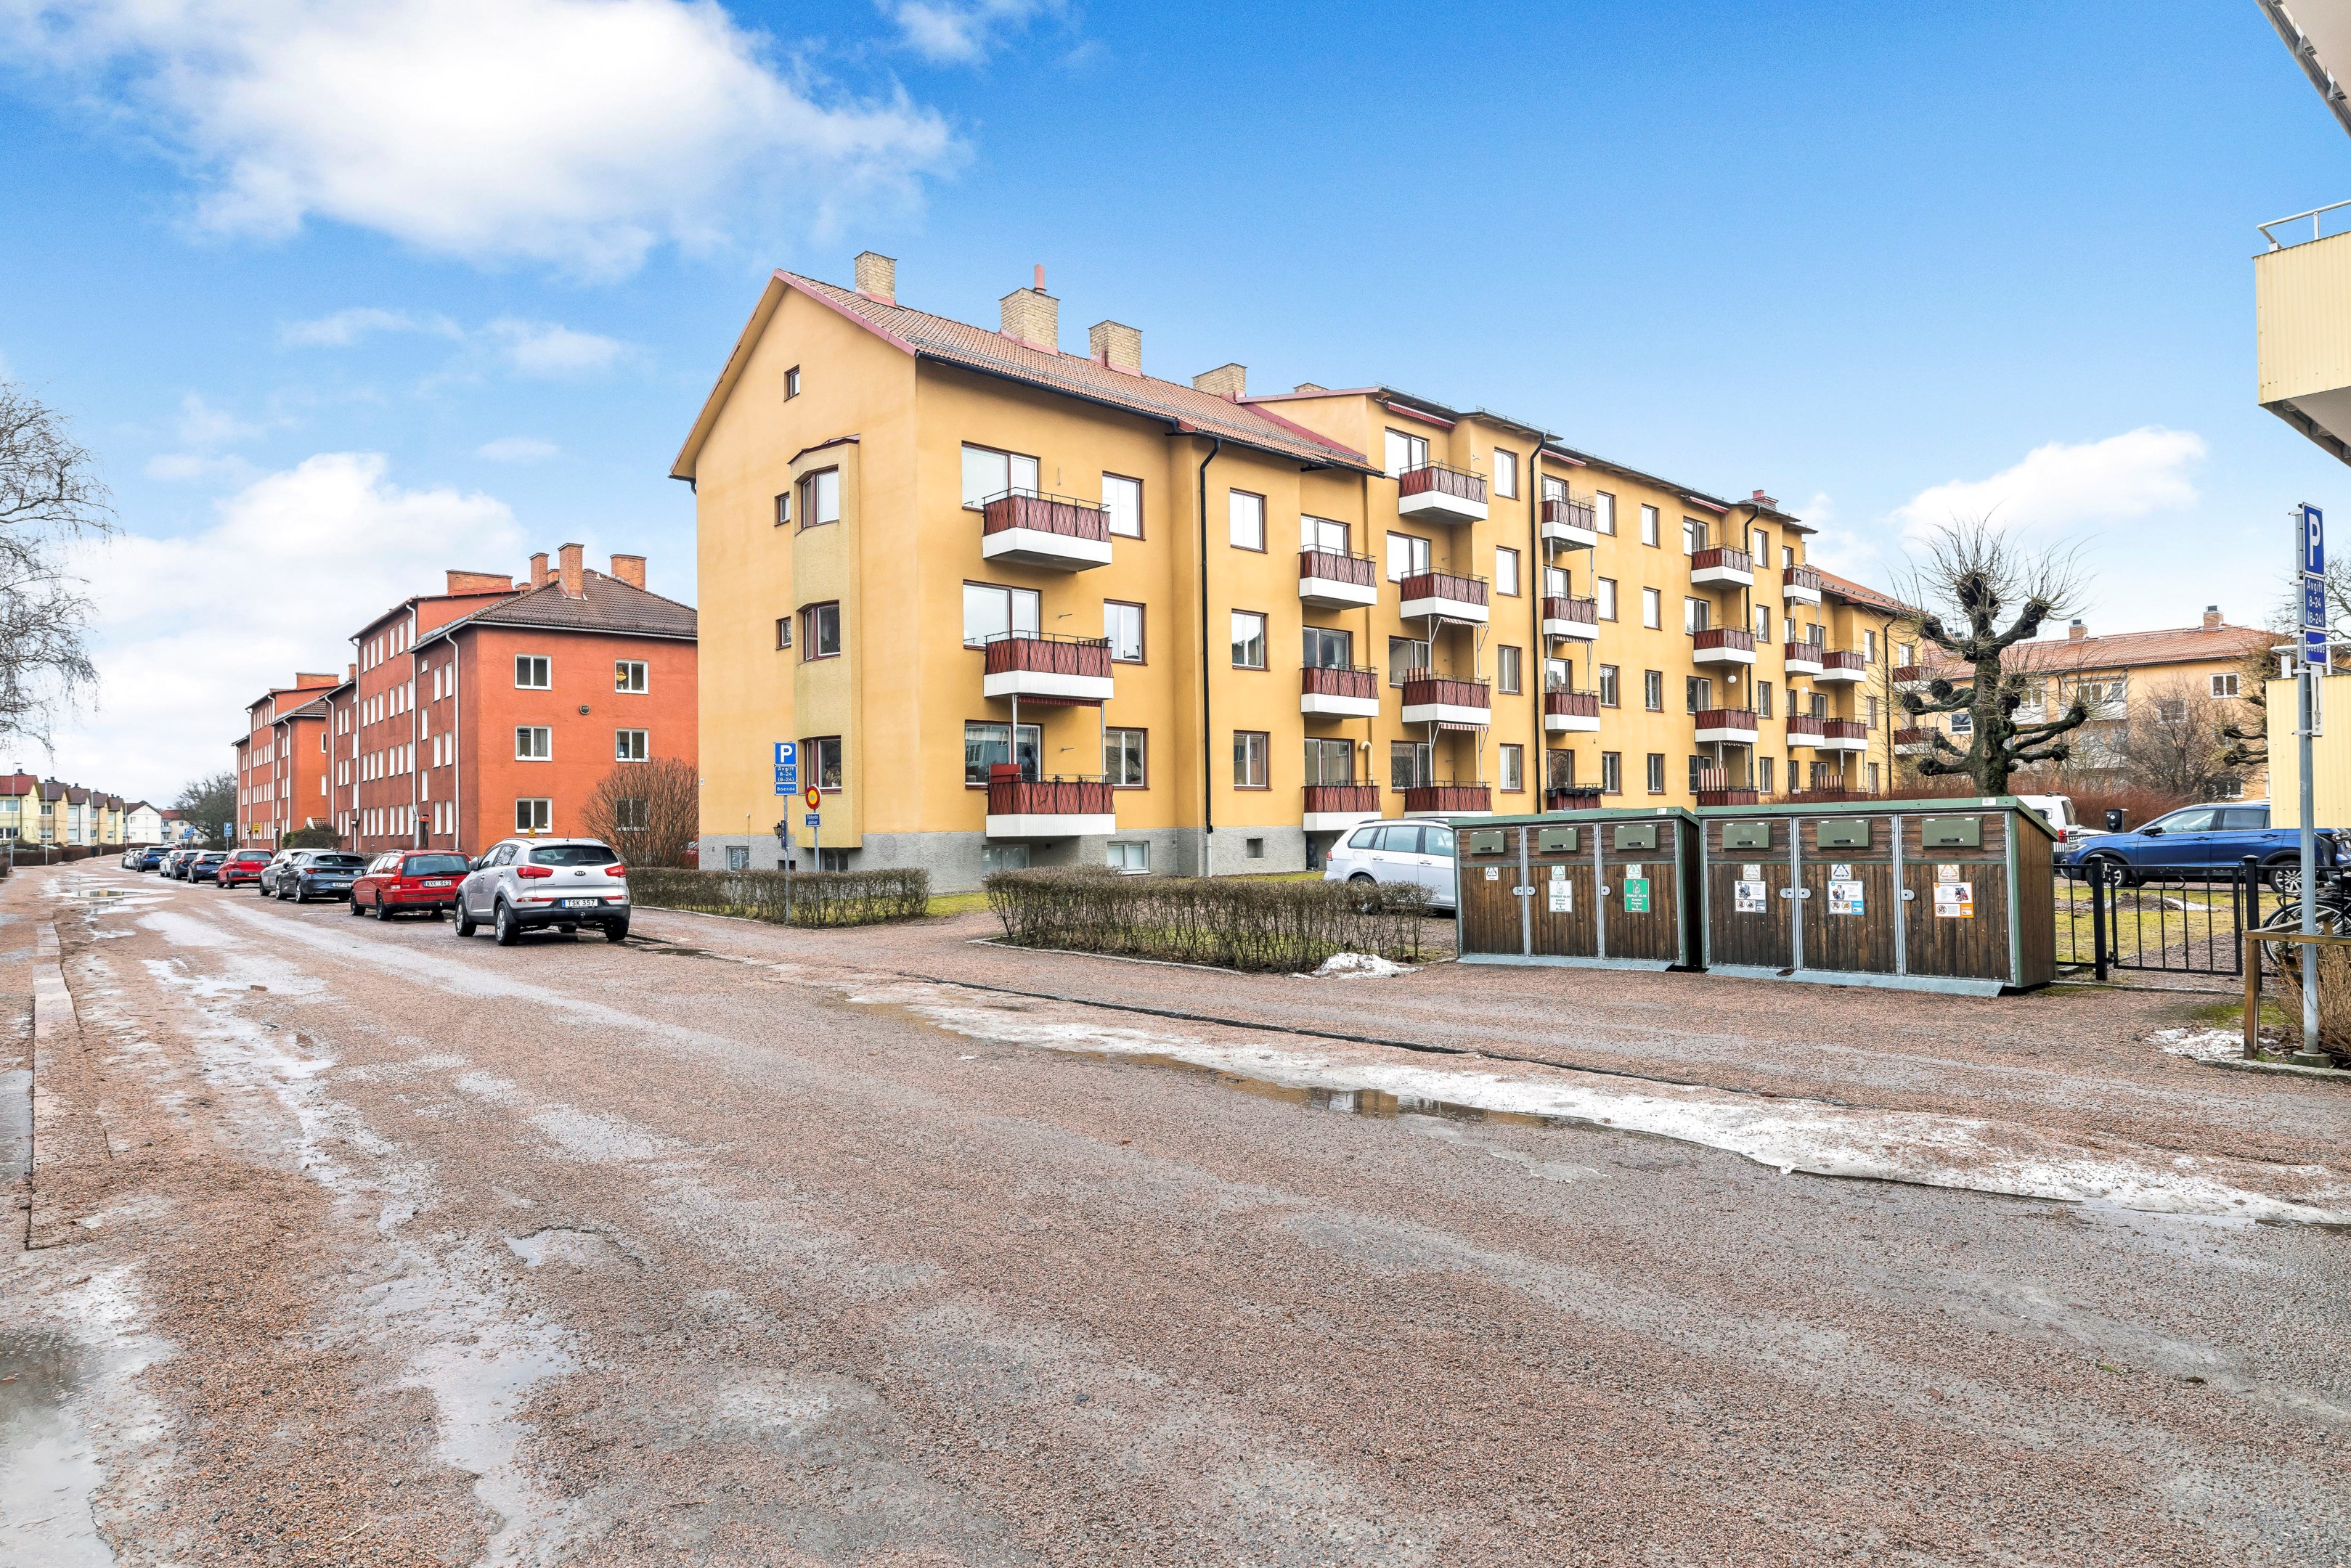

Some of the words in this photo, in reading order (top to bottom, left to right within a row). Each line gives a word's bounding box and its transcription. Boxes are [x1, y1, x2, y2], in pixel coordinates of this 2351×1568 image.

[2309, 513, 2321, 566] P
[2307, 579, 2323, 594] Avgift
[2309, 595, 2321, 608] 8-24
[2307, 610, 2323, 626] (8-24)
[780, 745, 793, 763] P
